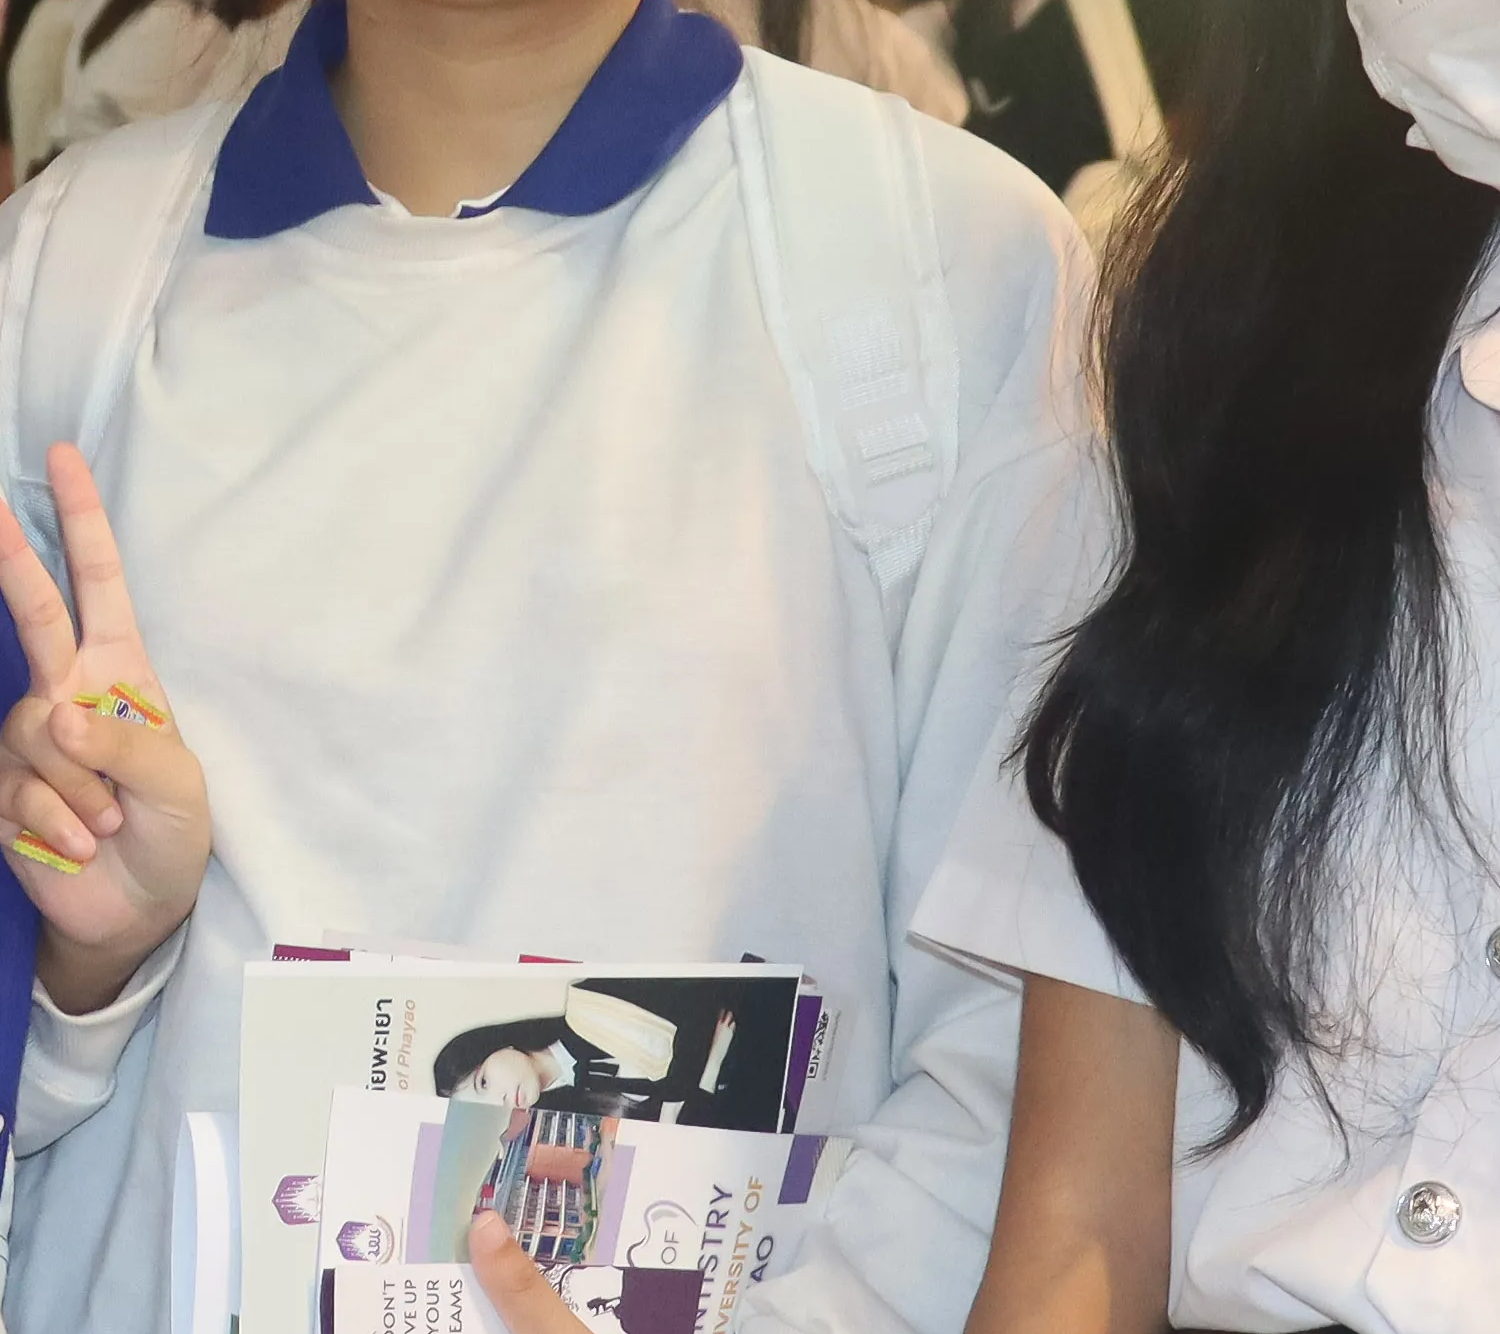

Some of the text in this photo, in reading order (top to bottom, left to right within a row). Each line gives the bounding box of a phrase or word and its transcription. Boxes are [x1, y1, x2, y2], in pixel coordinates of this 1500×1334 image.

[397, 999, 418, 1091] of Phayao
[743, 1174, 766, 1214] OF
[660, 1229, 678, 1266] OF
[404, 1279, 419, 1301] UP
